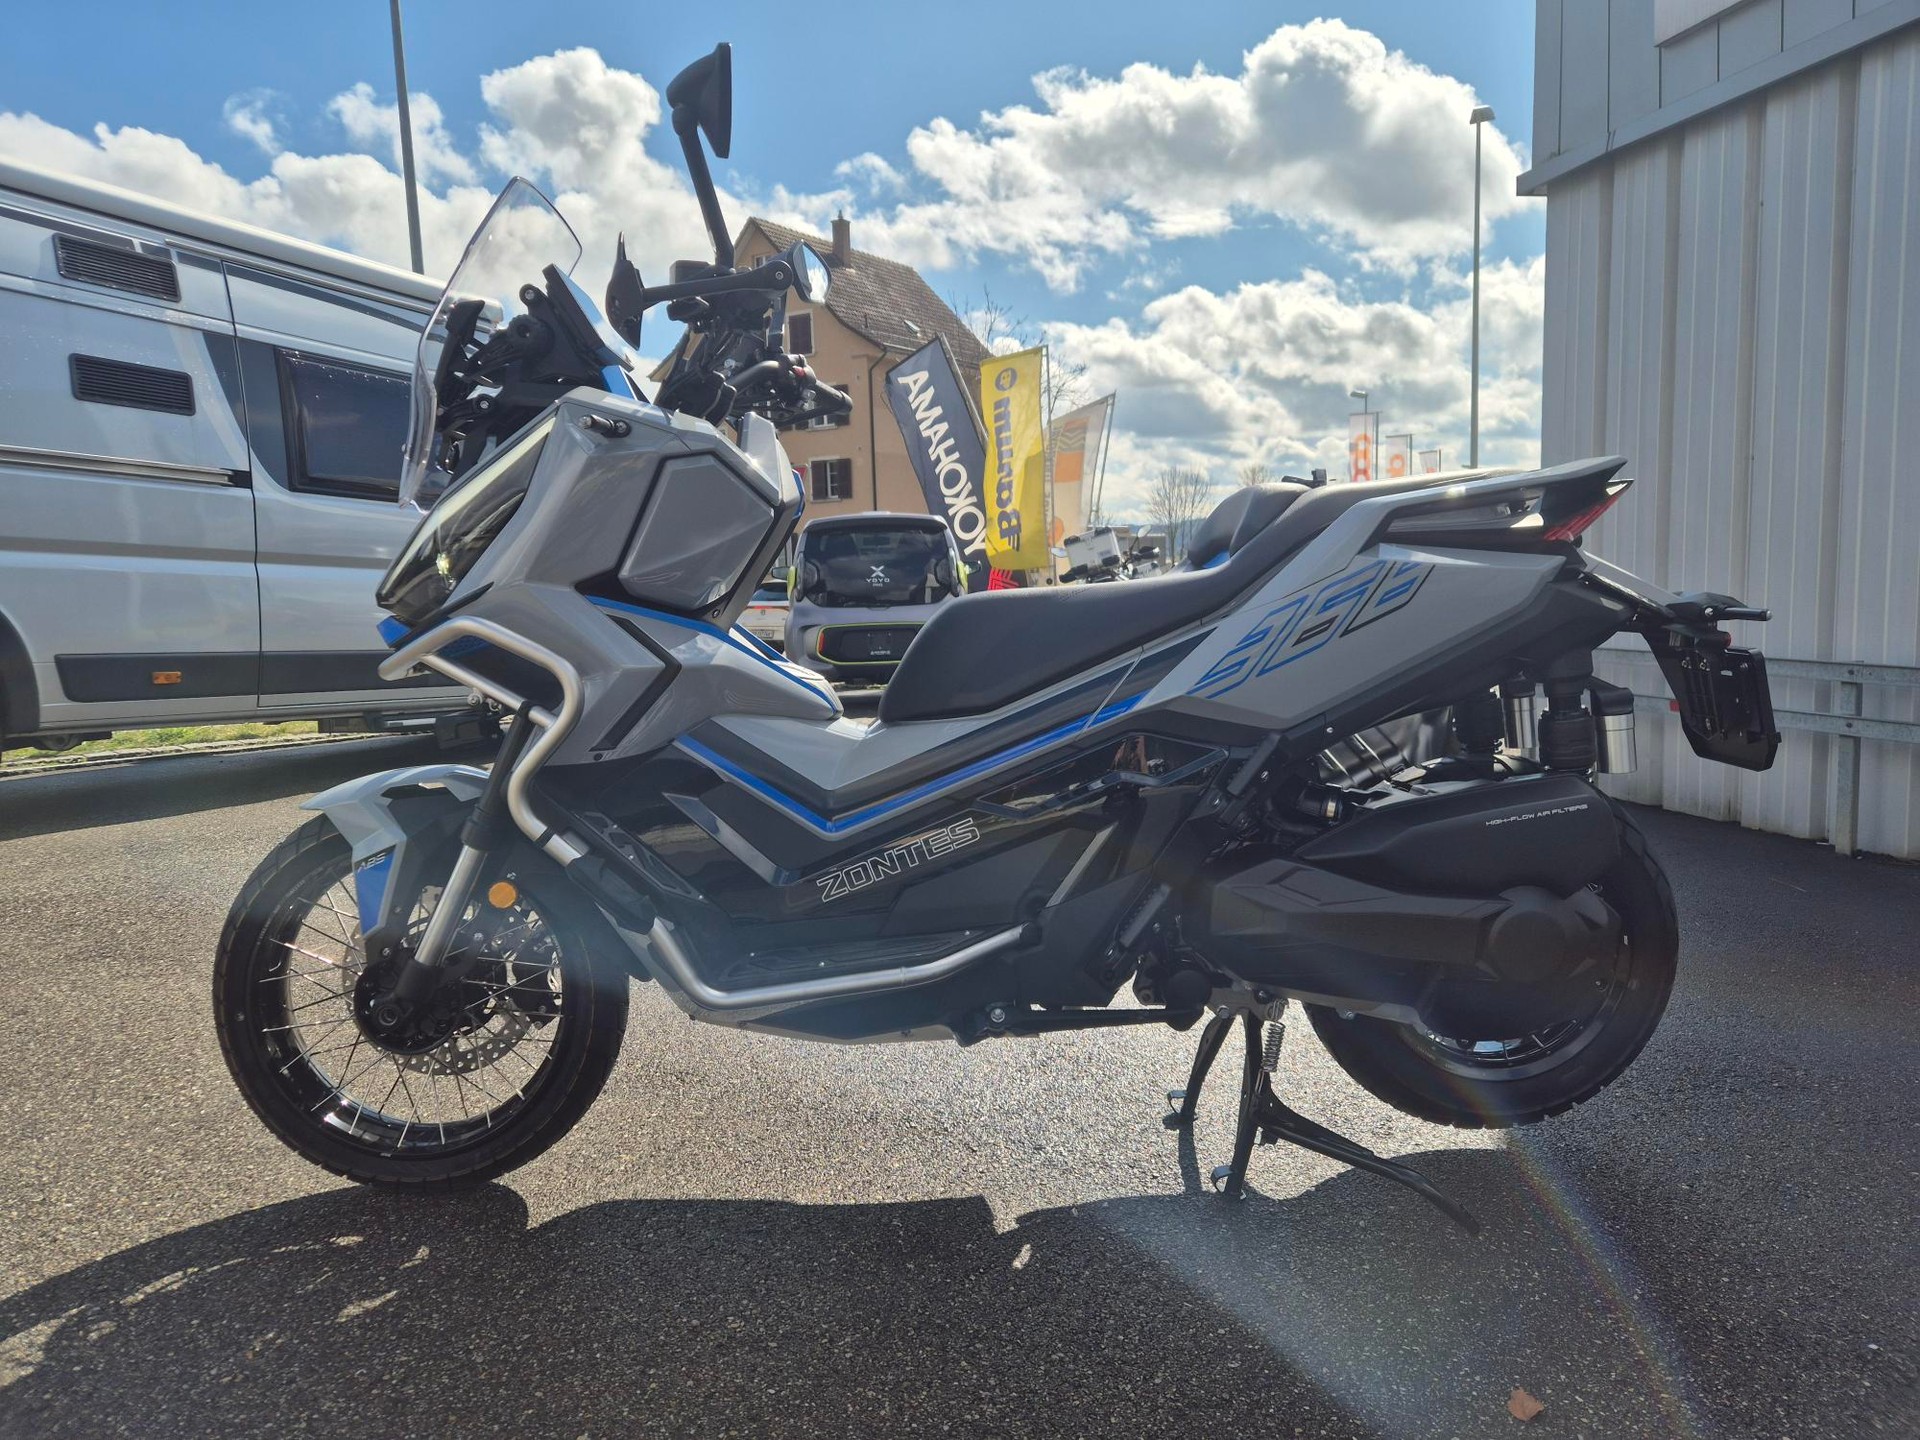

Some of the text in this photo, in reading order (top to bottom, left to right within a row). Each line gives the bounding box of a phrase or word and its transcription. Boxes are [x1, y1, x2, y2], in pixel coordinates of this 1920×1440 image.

[1485, 803, 1589, 826] HIGH-FLOW AIR FILTERS
[357, 851, 386, 873] ABS
[816, 817, 981, 903] ZONTES
